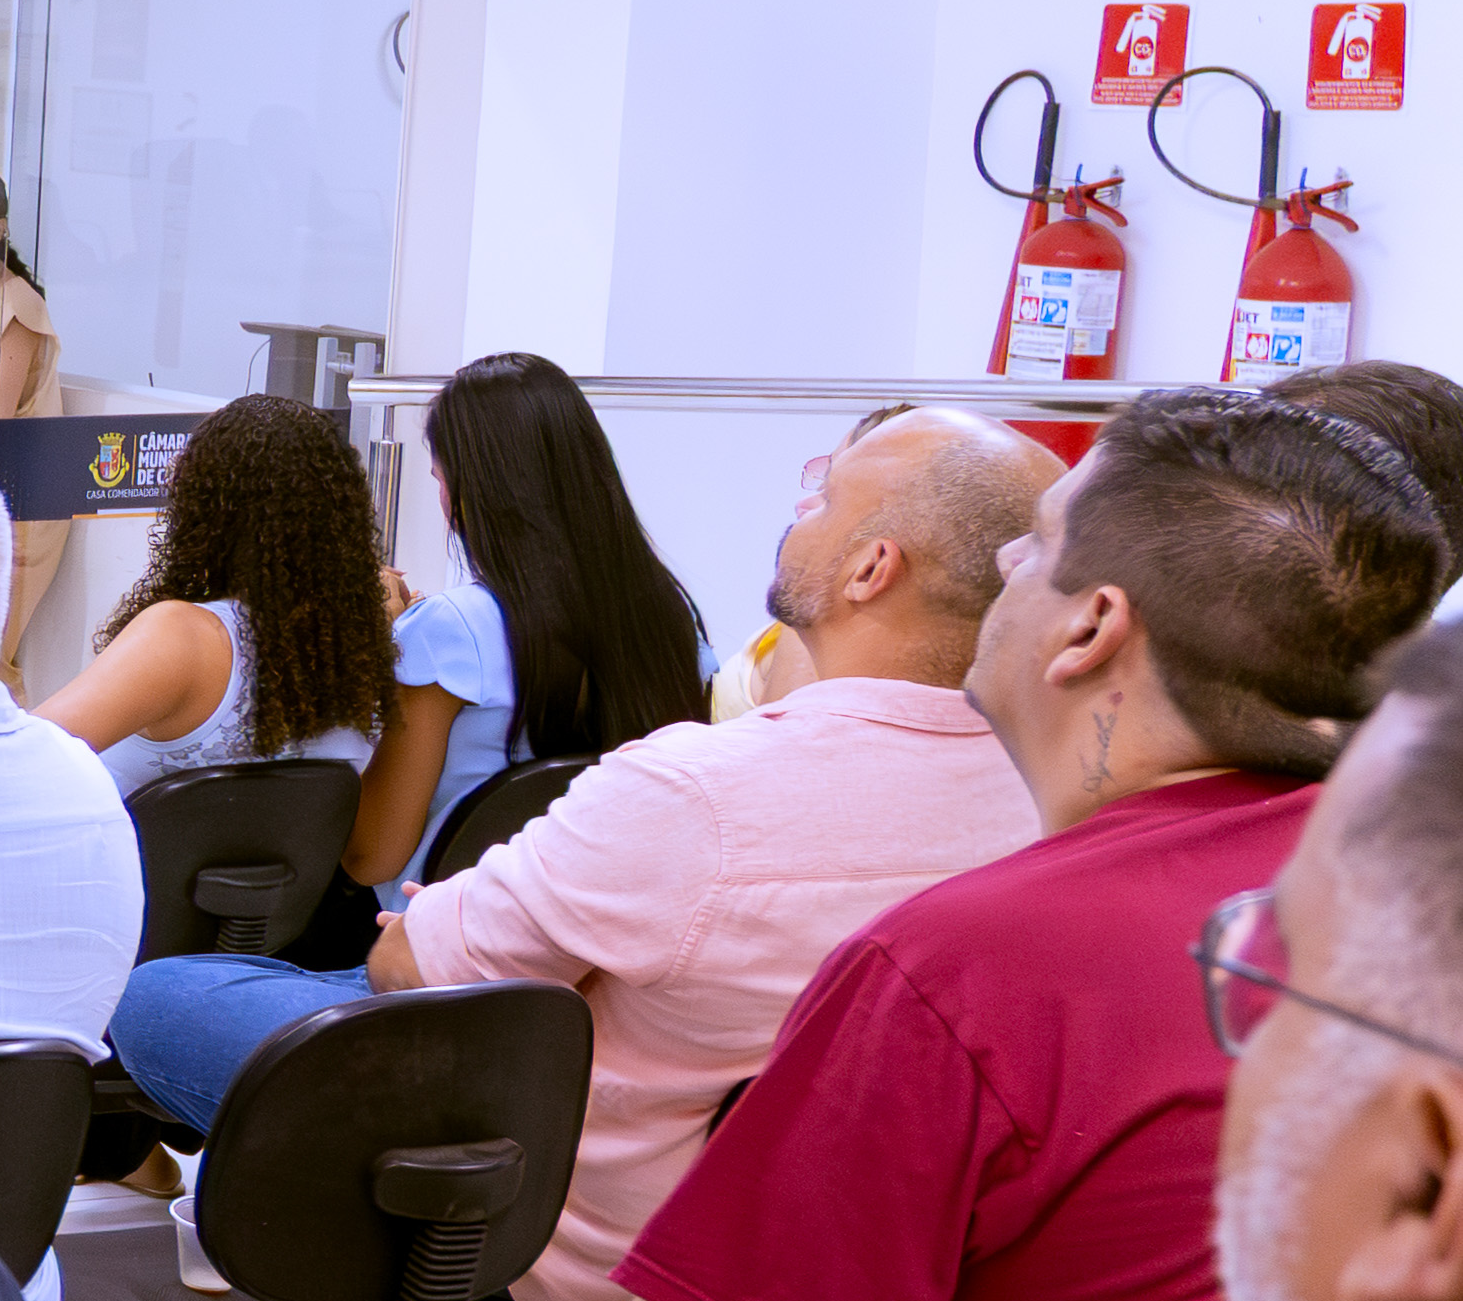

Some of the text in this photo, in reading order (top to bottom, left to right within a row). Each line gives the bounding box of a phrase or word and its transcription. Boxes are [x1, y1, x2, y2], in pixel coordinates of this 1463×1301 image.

[137, 468, 155, 486] DE
[86, 490, 106, 500] CASA
[107, 487, 159, 499] COMENDADOR
